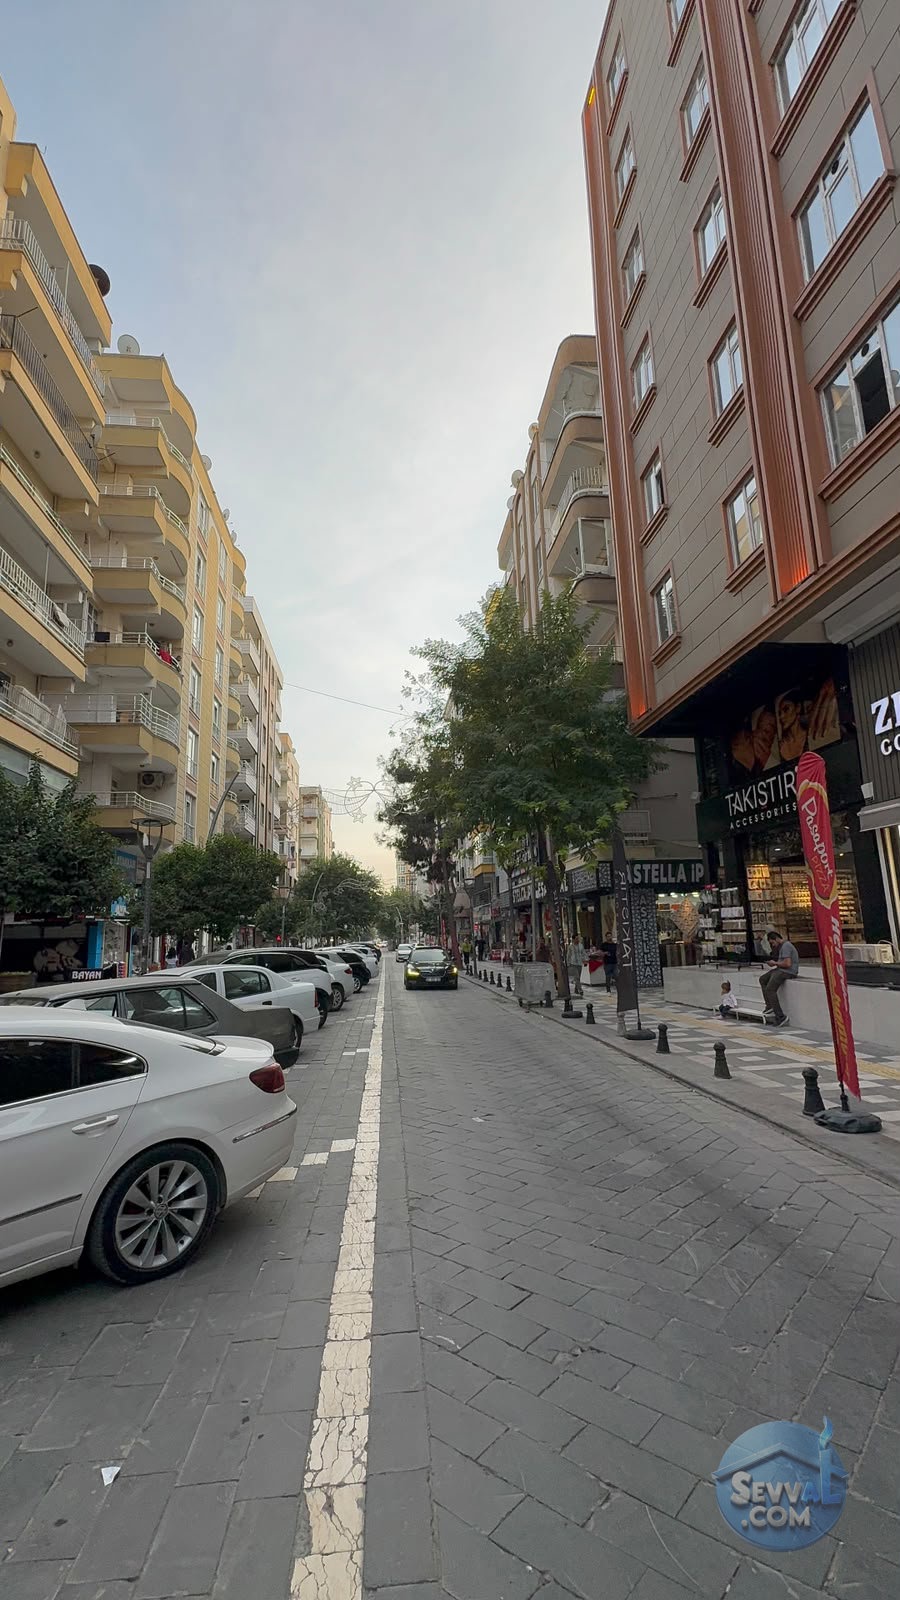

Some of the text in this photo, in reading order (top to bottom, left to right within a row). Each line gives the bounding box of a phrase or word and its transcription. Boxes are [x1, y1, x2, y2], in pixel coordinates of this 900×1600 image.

[729, 802, 797, 830] ACCESSORIES
[801, 796, 833, 876] Pasaport
[640, 895, 653, 977] ASTELLA
[71, 970, 102, 980] BAYAN
